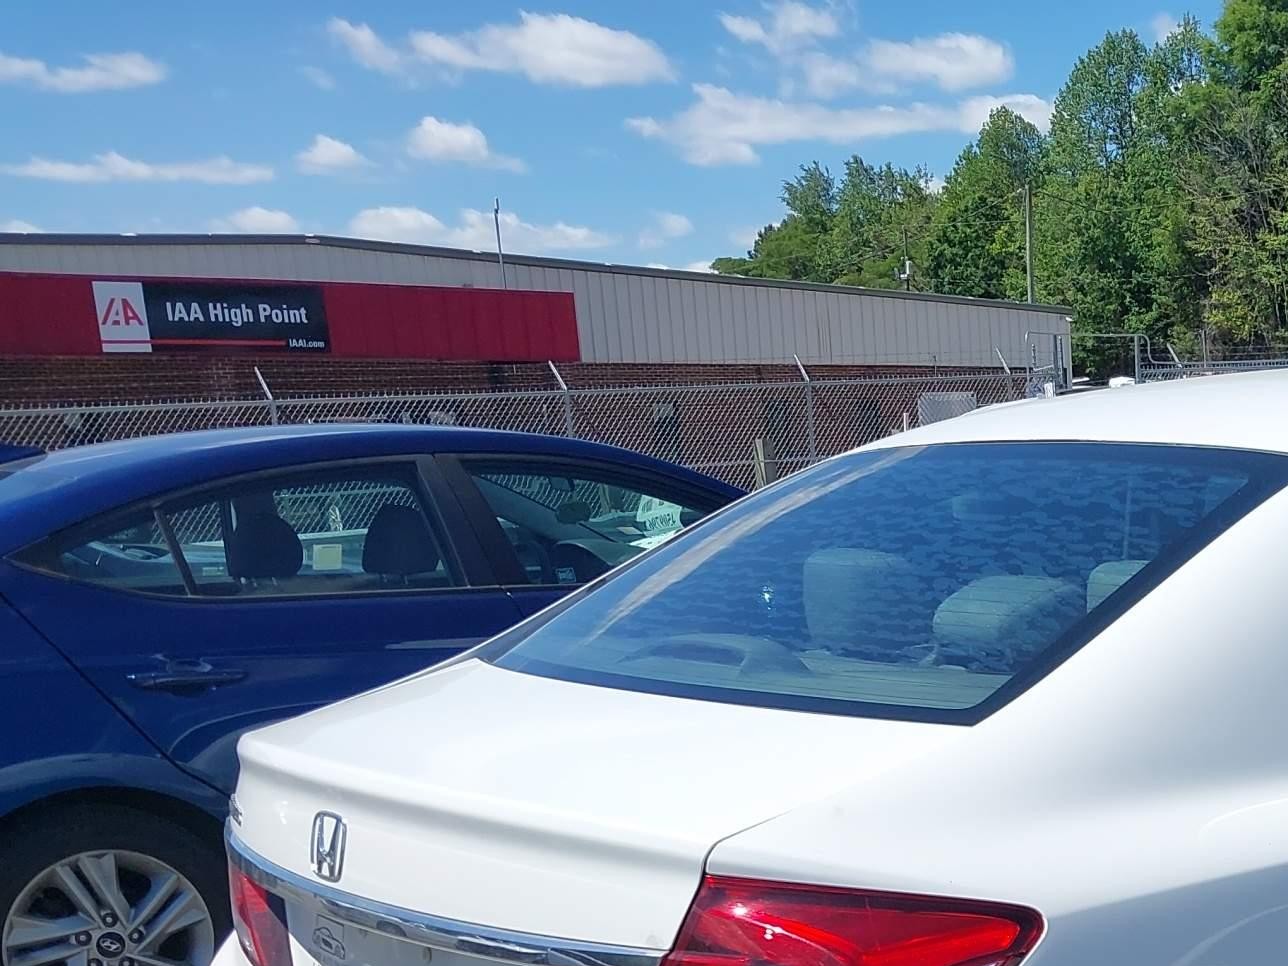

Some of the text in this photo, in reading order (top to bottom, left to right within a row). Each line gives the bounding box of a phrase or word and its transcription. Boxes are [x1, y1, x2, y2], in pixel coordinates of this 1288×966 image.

[166, 302, 308, 327] IAA High Point
[288, 338, 325, 348] IAAI.com
